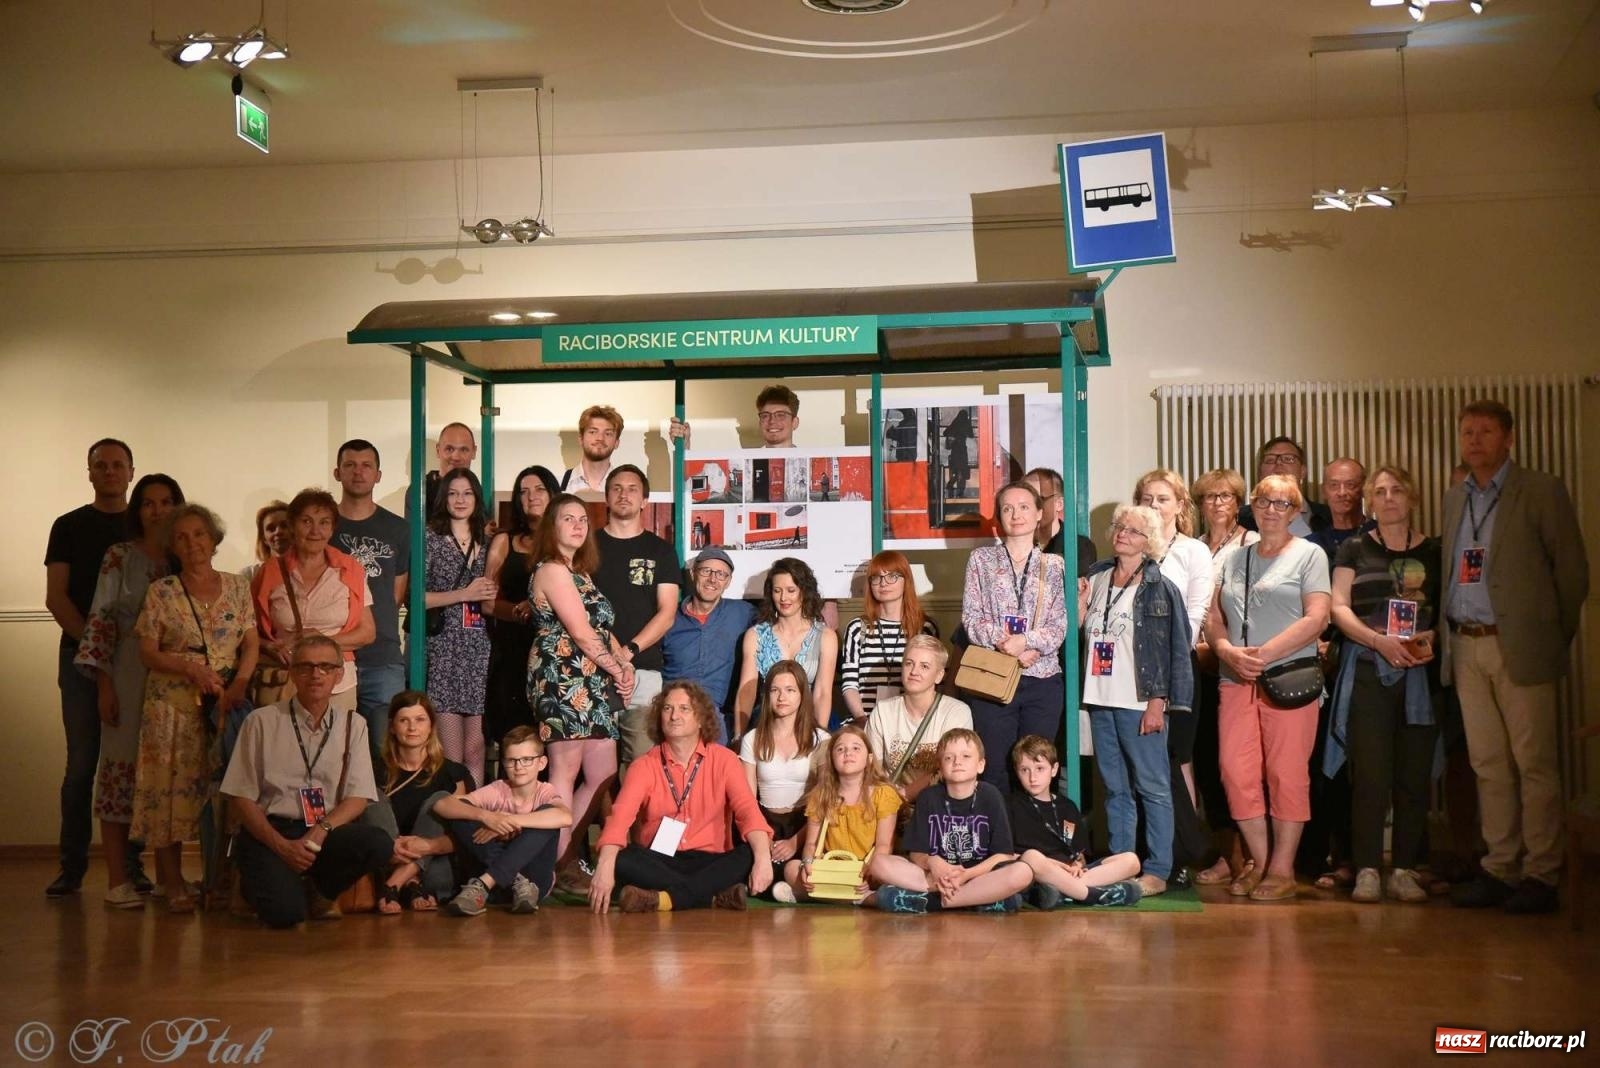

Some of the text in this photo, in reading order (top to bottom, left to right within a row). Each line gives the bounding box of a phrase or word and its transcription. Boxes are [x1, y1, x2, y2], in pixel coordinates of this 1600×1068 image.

[559, 325, 860, 351] RACIBORSKIE CENTRUM KULTURY
